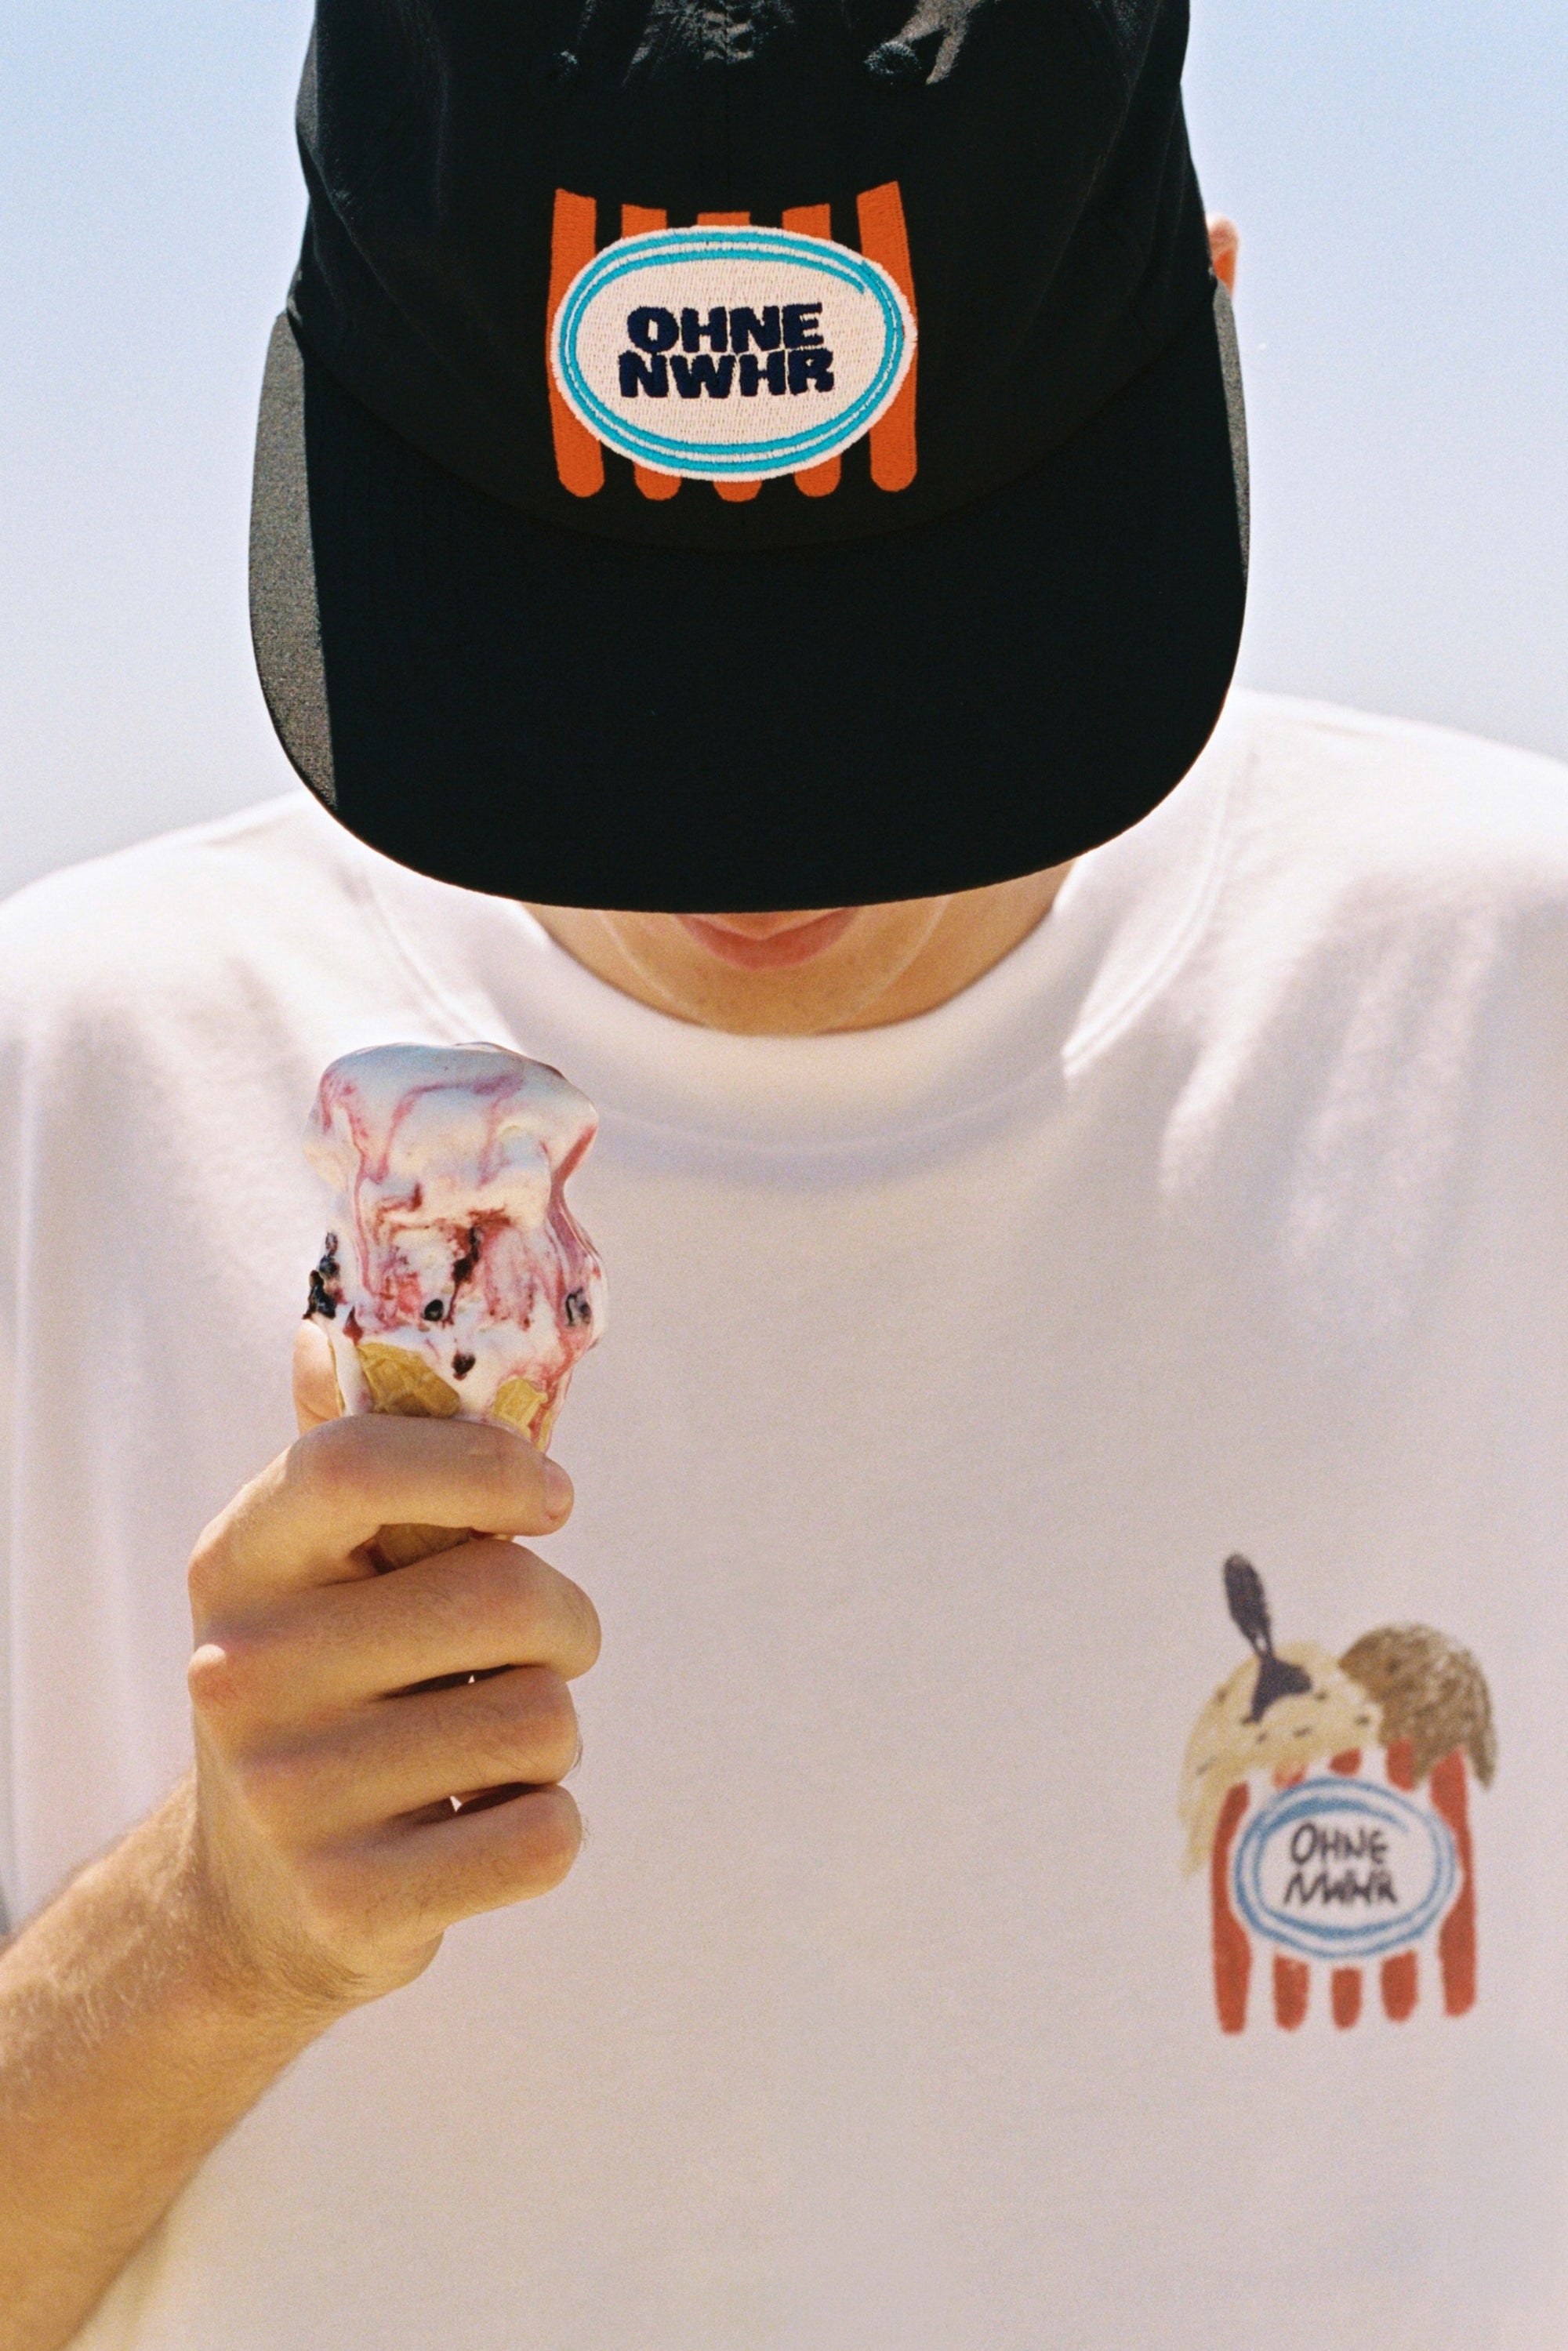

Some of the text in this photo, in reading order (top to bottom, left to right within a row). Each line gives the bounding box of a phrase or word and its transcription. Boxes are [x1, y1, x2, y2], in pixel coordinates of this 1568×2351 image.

[627, 303, 823, 353] OHNE
[619, 348, 834, 398] NWHR
[1290, 1822, 1388, 1866] OHNE
